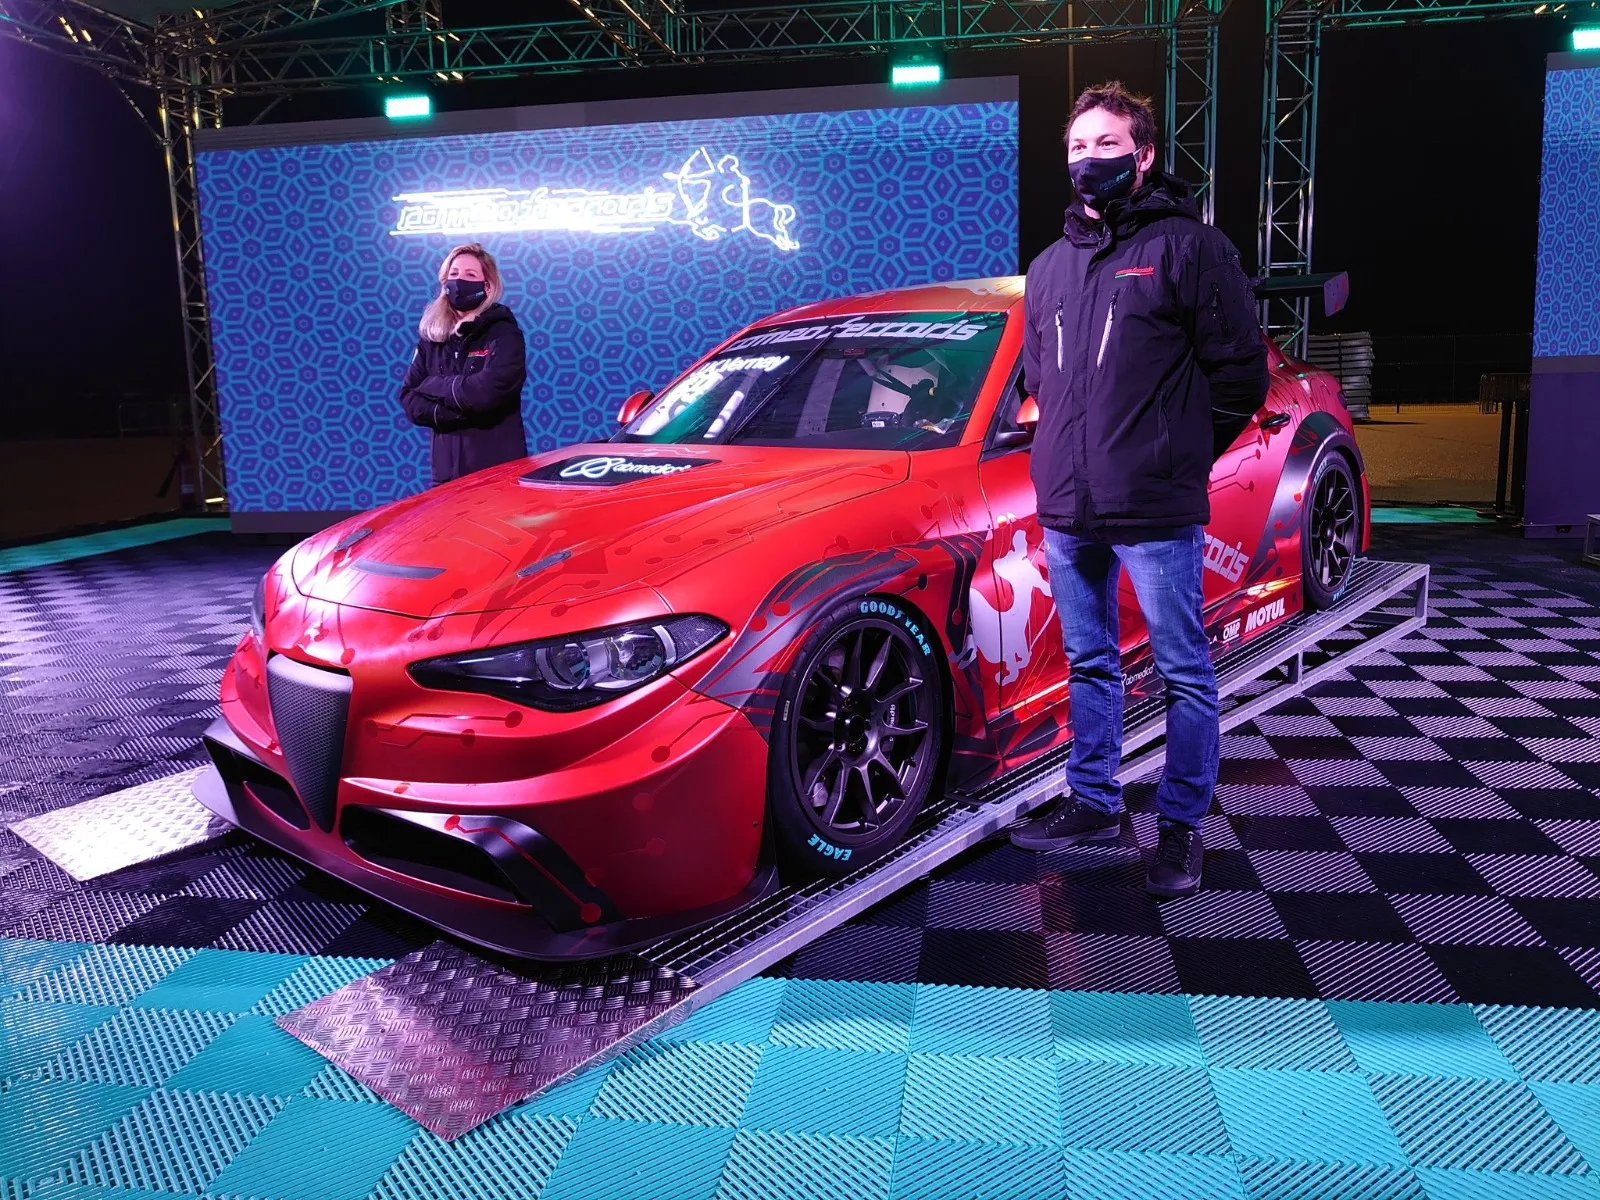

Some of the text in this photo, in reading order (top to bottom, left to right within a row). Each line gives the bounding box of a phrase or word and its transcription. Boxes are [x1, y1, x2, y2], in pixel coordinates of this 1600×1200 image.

[1223, 597, 1285, 640] OMP MOTUL
[807, 833, 852, 861] EAGLE
